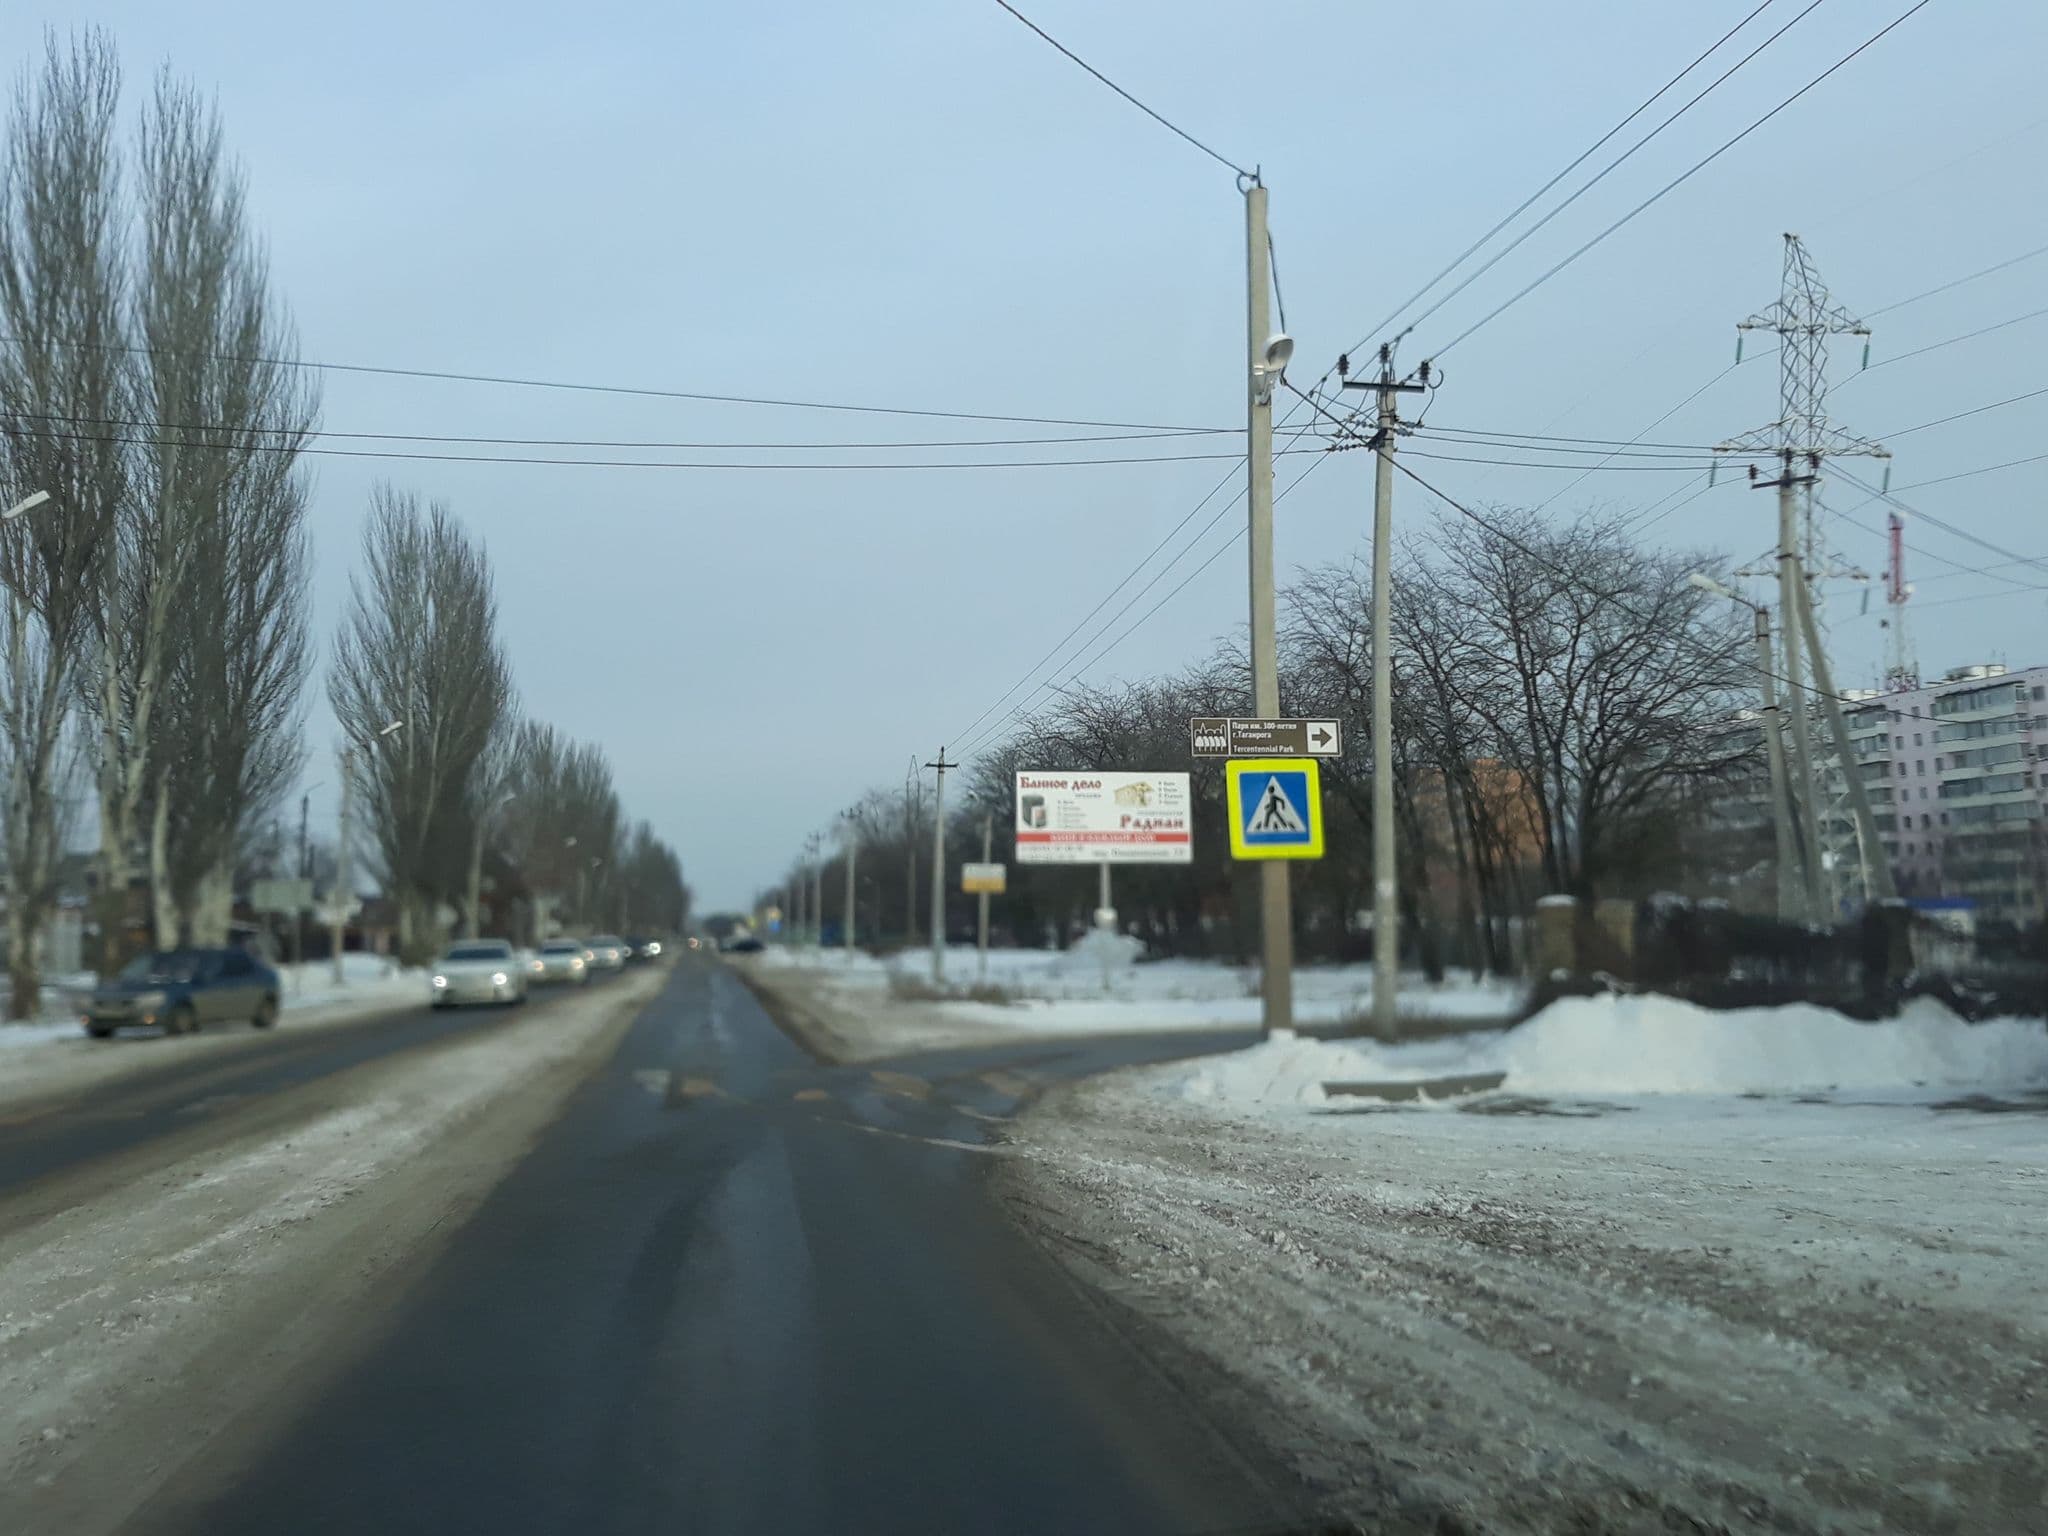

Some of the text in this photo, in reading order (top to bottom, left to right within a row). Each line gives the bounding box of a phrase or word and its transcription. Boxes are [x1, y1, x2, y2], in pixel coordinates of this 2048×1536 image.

[1232, 721, 1249, 730] Парк
[1233, 744, 1295, 753] Tercentennial Park
[1020, 776, 1102, 791] Банное дело
